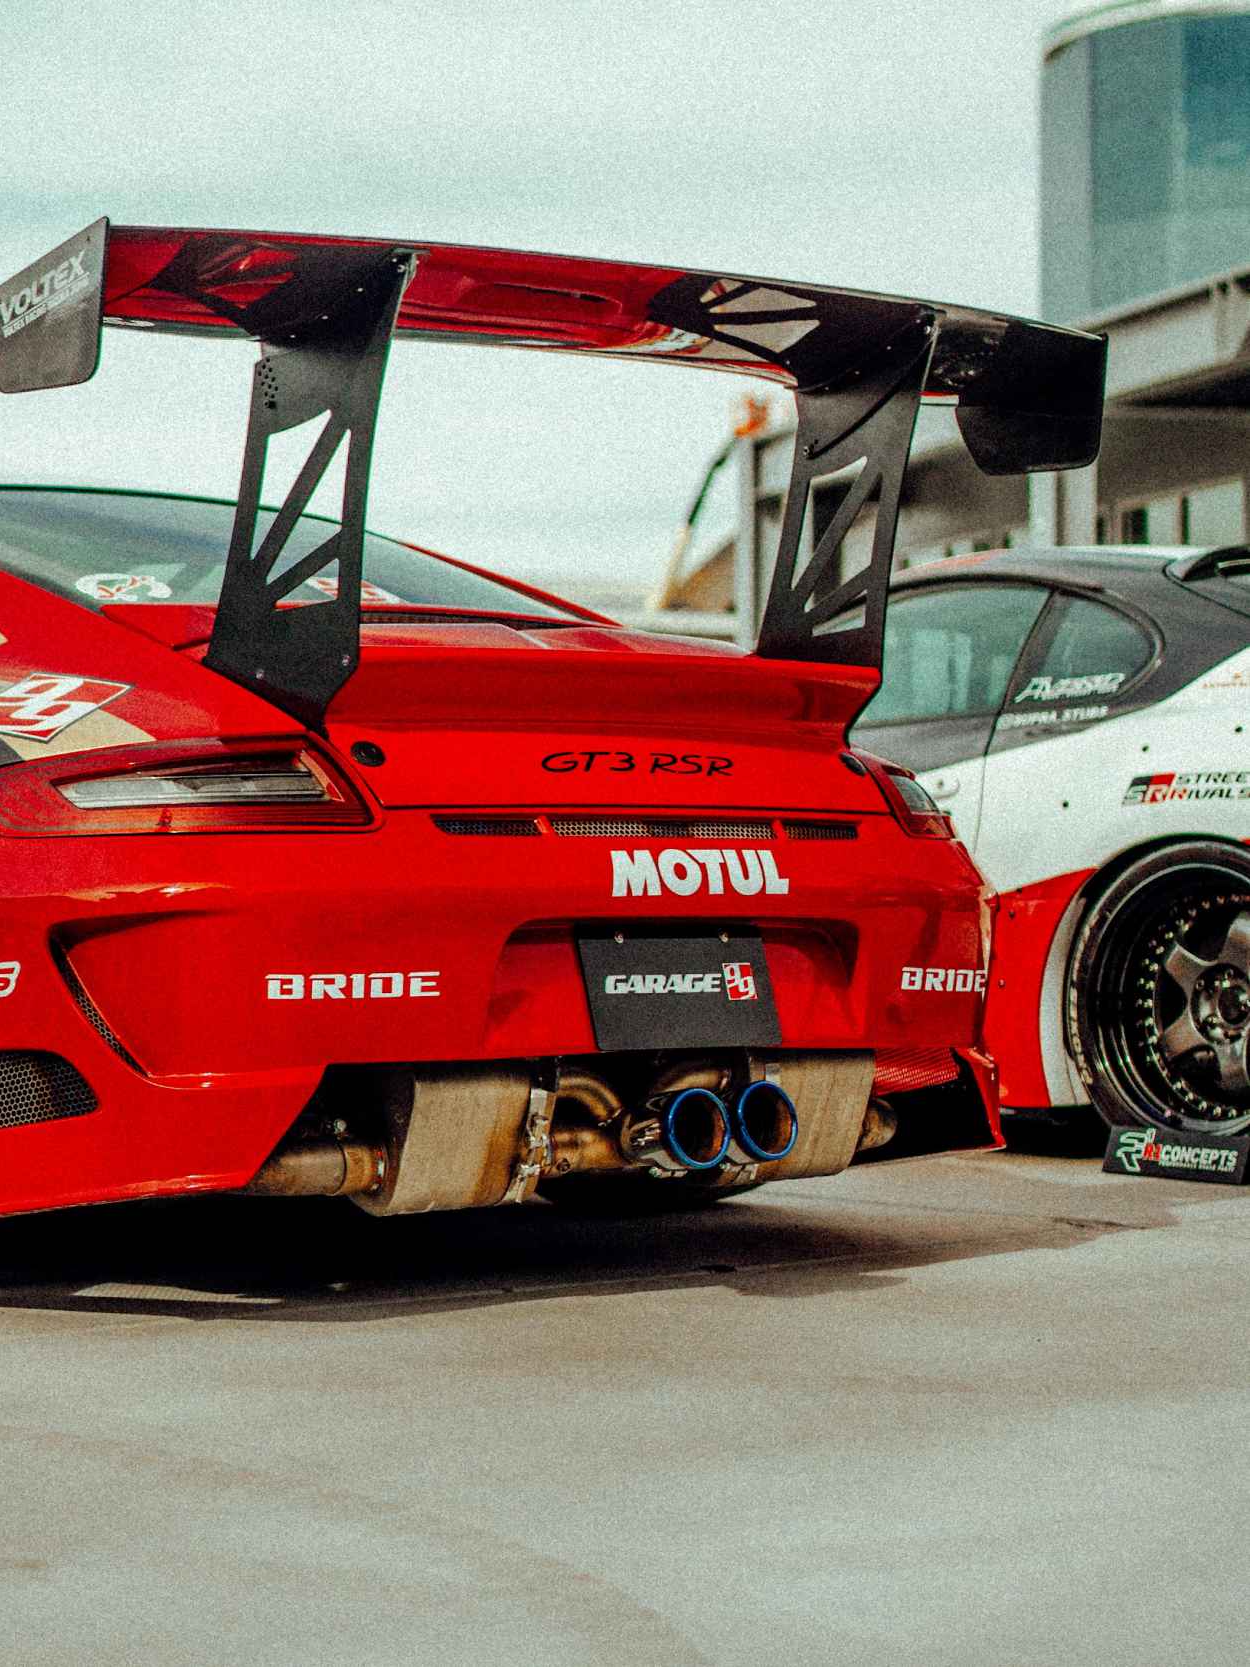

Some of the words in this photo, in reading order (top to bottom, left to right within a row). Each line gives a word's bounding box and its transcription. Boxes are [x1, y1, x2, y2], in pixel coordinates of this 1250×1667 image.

[541, 751, 636, 773] GT3
[649, 752, 734, 777] RSR
[610, 848, 790, 898] MOTUL
[265, 971, 441, 999] BRIDE
[604, 973, 722, 995] GARAGE
[722, 962, 758, 1001] 99
[900, 966, 988, 993] BRIDE
